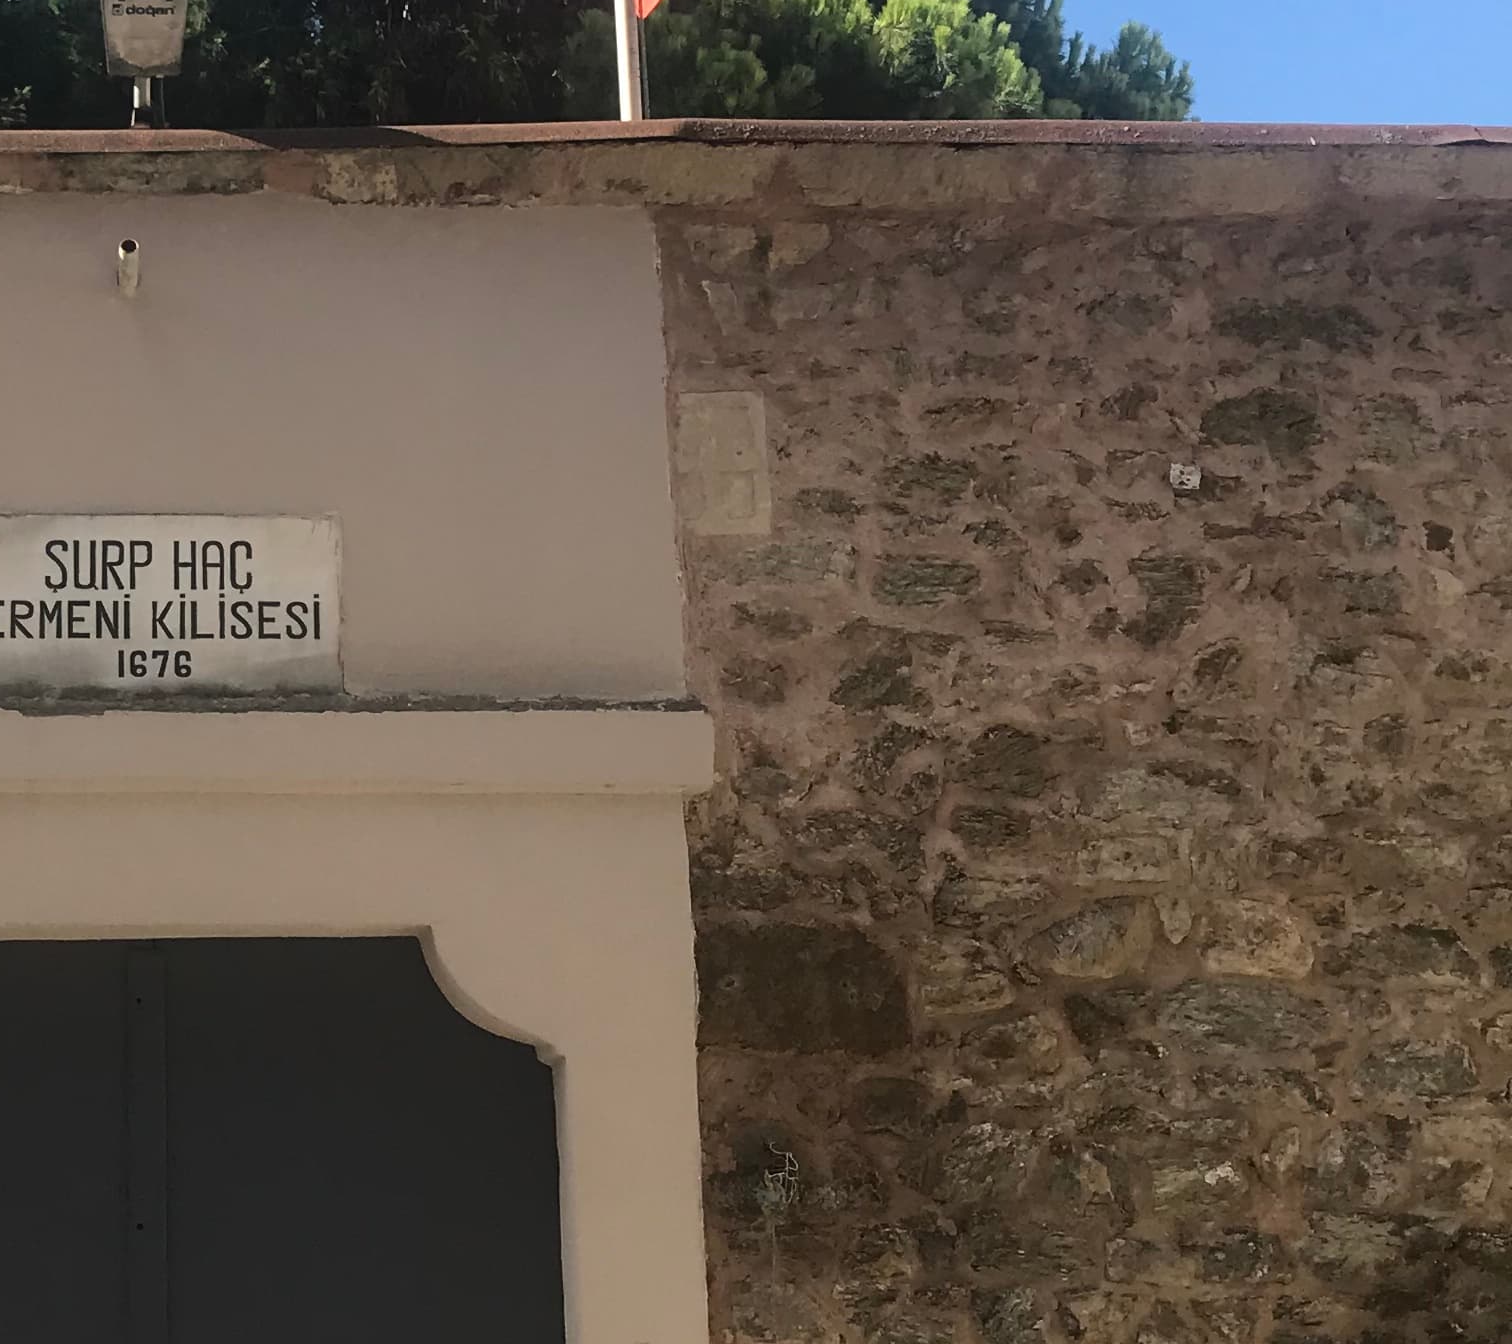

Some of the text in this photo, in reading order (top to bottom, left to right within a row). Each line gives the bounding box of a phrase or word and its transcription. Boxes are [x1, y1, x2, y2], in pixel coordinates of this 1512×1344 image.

[173, 540, 253, 594] HAÇ
[151, 593, 320, 641] KİLİSESİ
[117, 649, 192, 679] 1676
